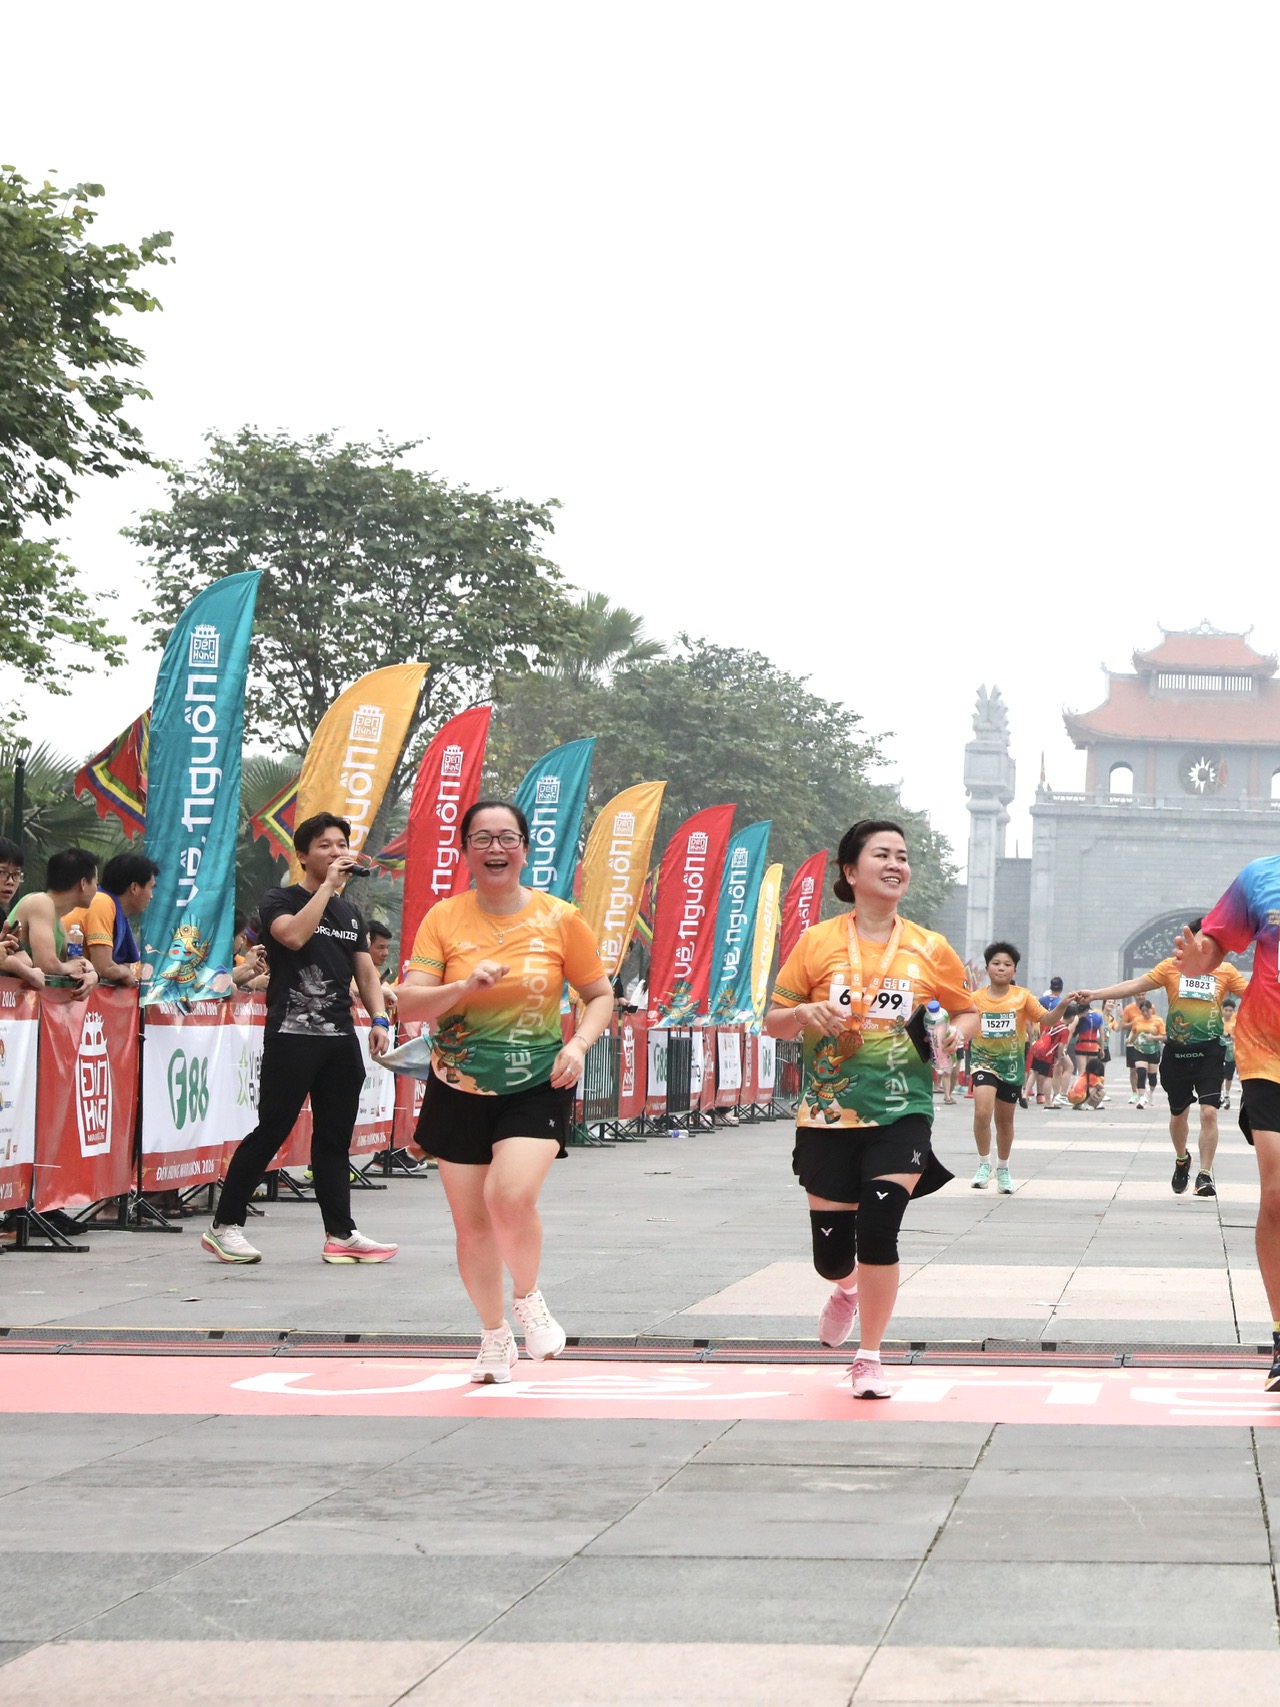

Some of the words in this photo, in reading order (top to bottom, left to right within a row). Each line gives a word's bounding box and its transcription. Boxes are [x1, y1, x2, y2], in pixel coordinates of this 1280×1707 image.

[530, 808, 558, 892] guồn
[1185, 979, 1211, 990] 18823
[839, 989, 903, 1010] 699
[987, 1020, 1010, 1028] 15277
[168, 1048, 209, 1131] F88
[202, 1159, 215, 1175] 2026
